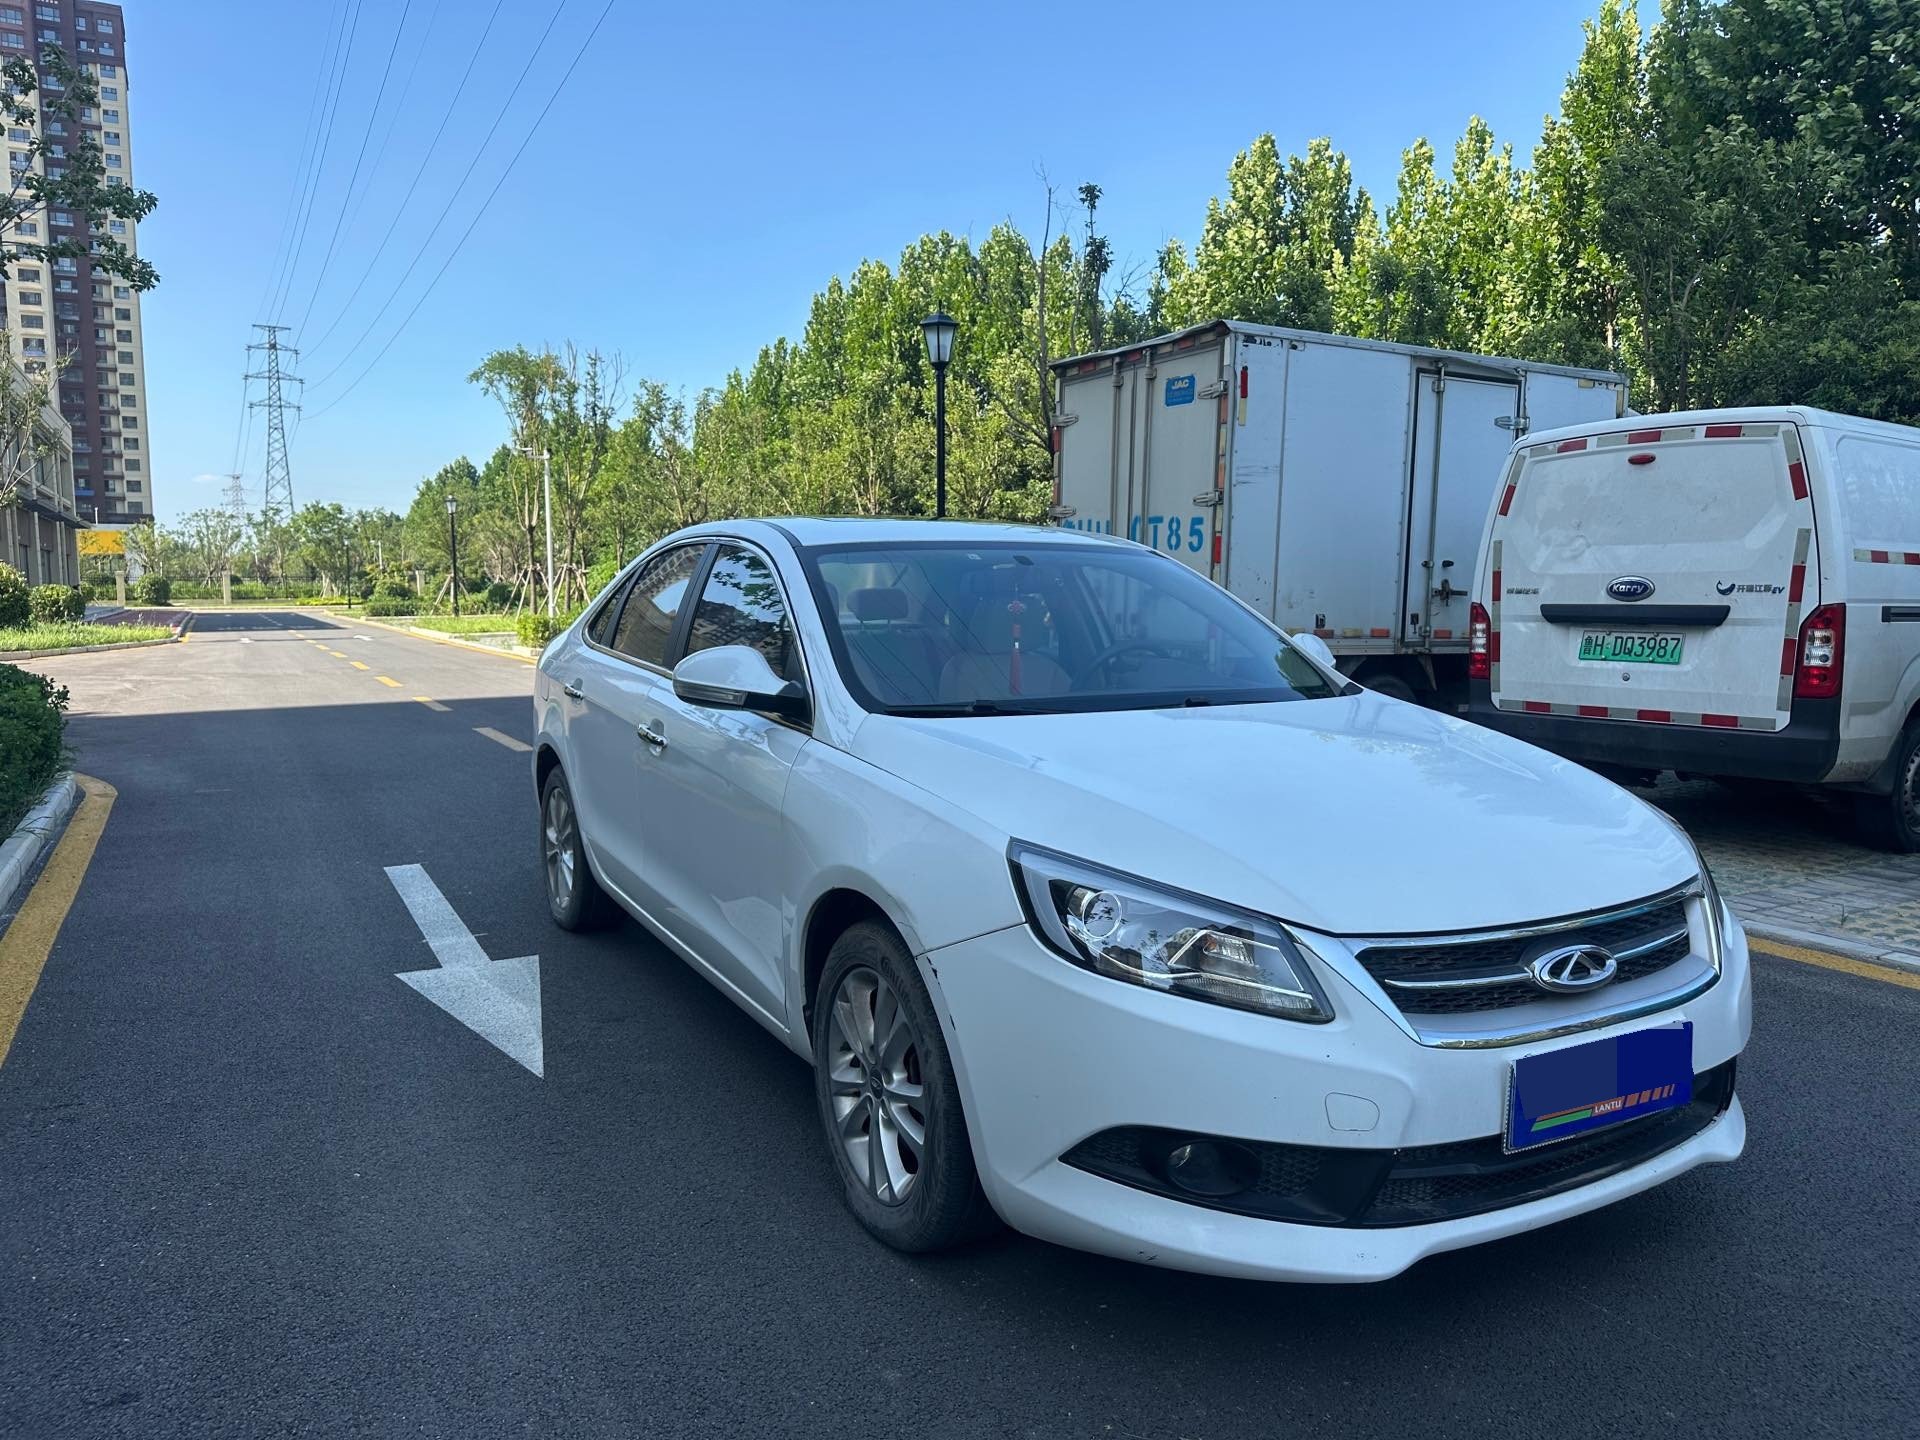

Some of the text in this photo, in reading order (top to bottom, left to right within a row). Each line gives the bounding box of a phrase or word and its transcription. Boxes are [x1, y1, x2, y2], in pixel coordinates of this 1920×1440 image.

[1171, 379, 1190, 389] JAC
[1612, 583, 1645, 593] Karry
[1594, 1100, 1621, 1113] LANTU
